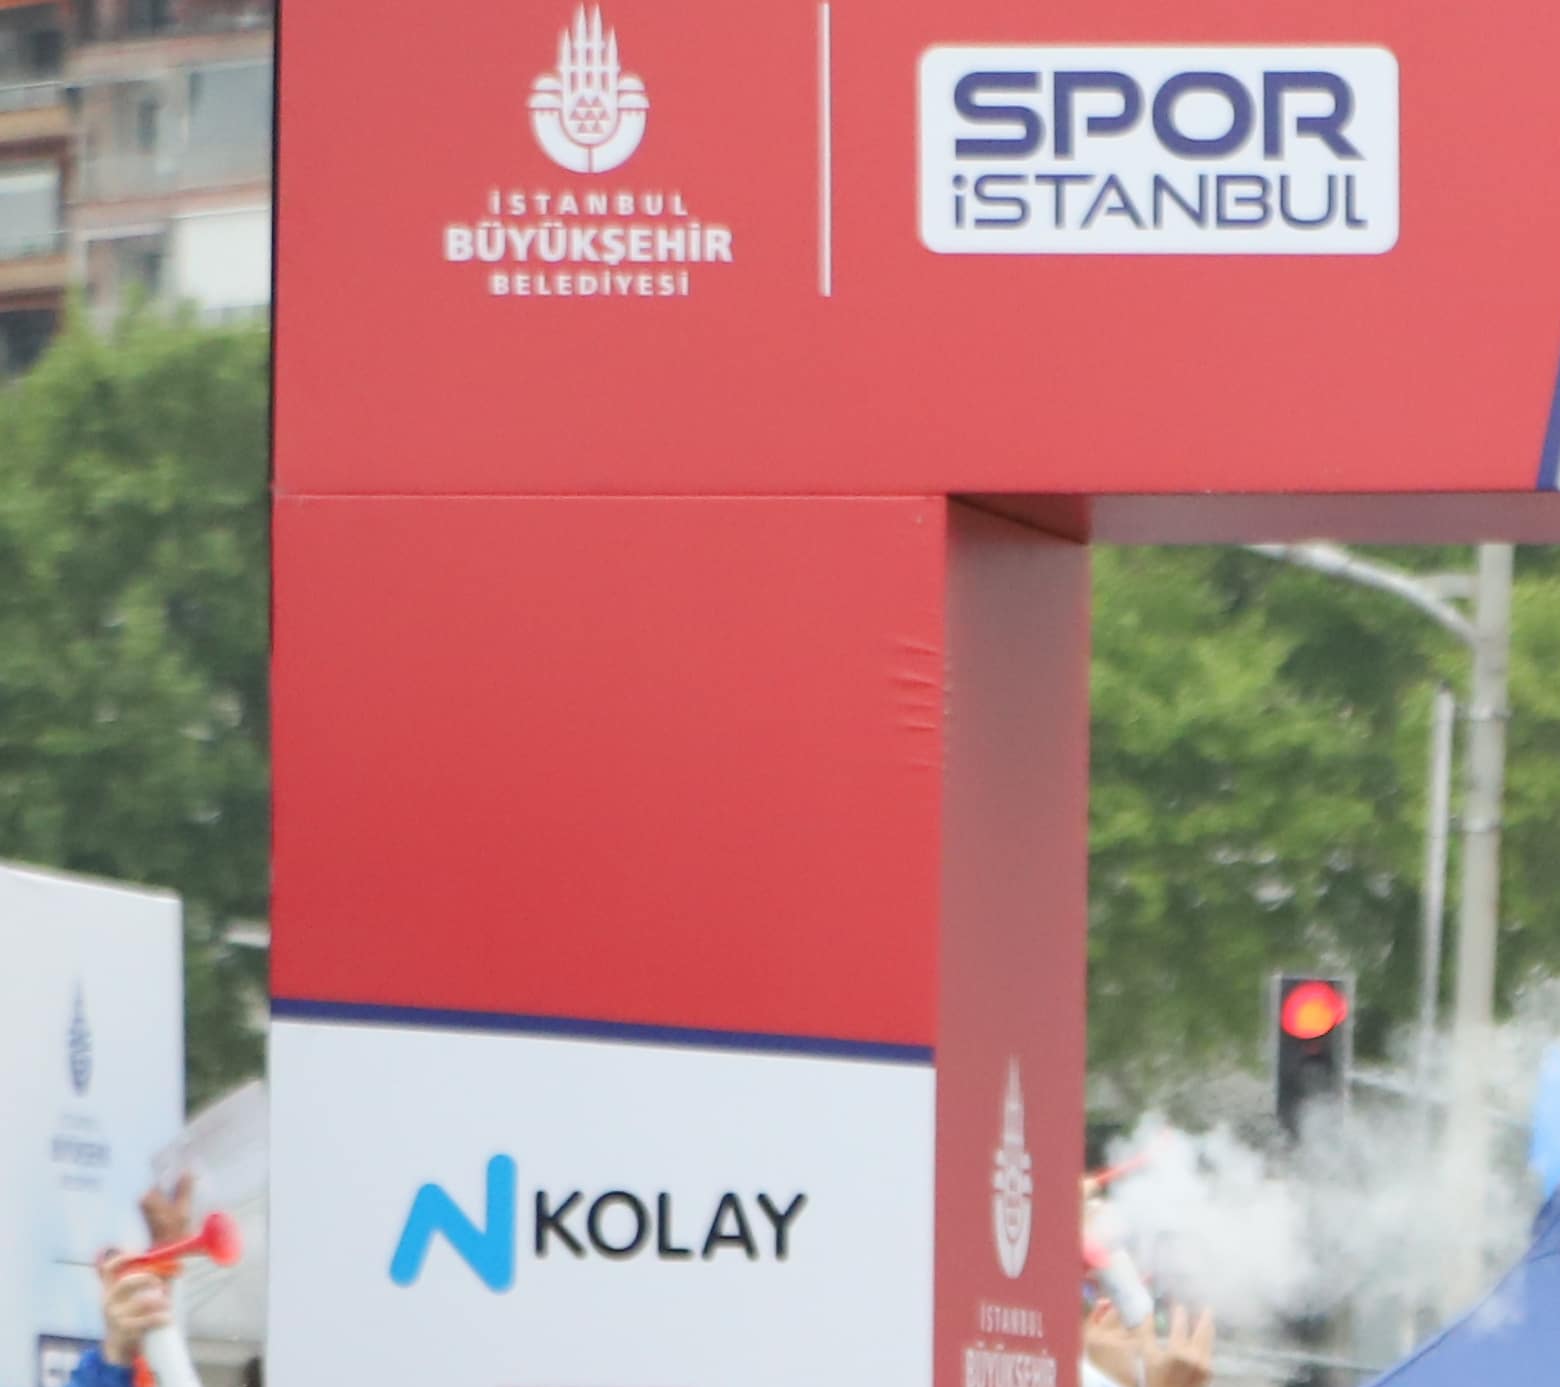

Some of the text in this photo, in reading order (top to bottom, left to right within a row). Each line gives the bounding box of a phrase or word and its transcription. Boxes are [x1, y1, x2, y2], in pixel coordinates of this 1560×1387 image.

[953, 69, 1361, 160] SPOR
[488, 186, 688, 216] İSTANBUL
[444, 220, 734, 268] BÜYÜKŞEHİR
[490, 269, 691, 298] BELEDİYESİ
[533, 1189, 807, 1262] KOLAY
